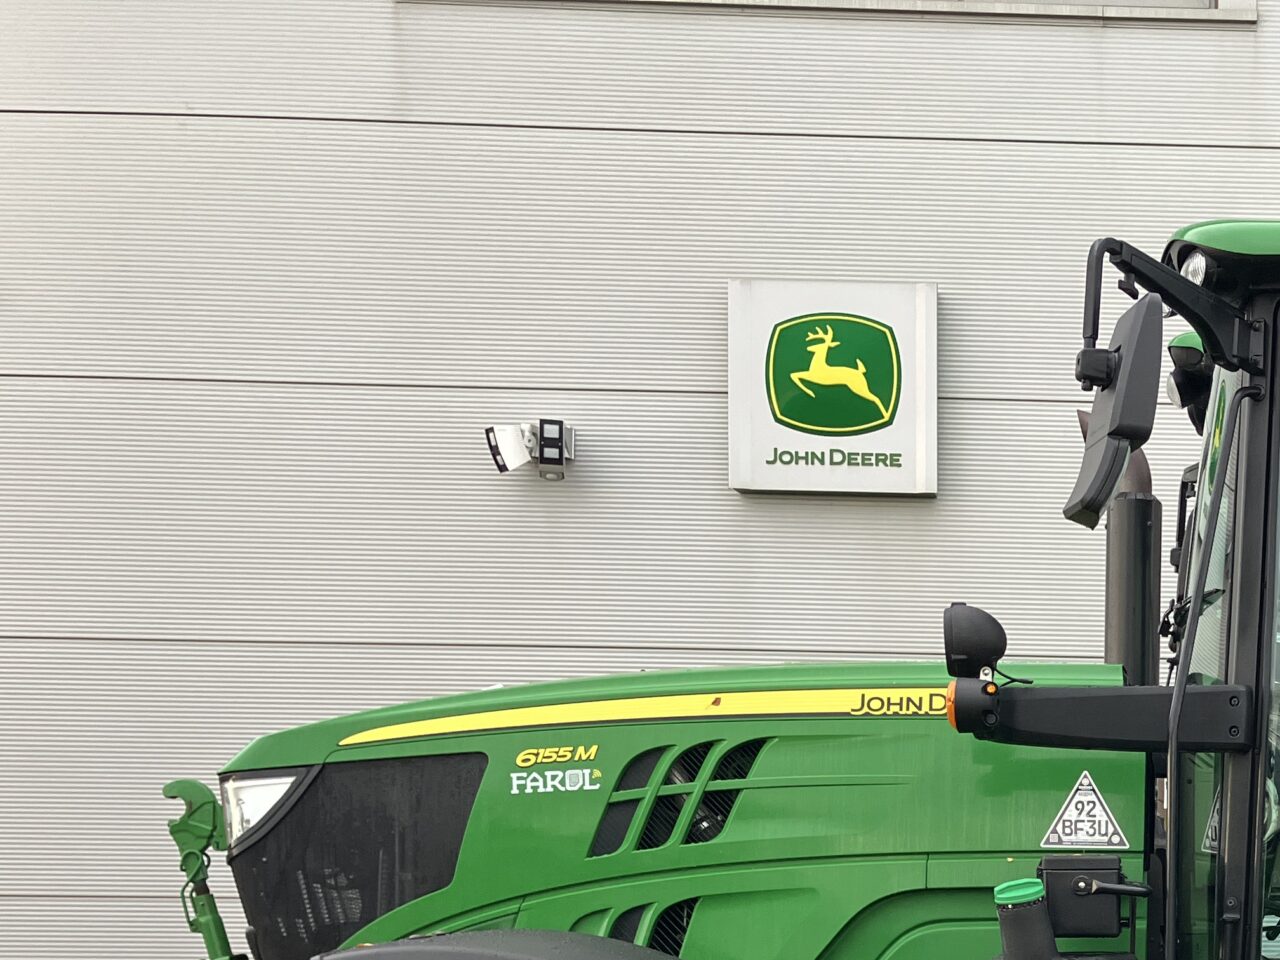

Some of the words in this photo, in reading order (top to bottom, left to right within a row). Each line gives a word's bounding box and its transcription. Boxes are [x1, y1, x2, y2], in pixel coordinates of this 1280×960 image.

[765, 447, 825, 466] JOHN
[829, 449, 903, 468] DEERE
[850, 693, 923, 712] JOHN
[509, 768, 601, 795] FAROL
[1074, 800, 1097, 818] 92
[1061, 819, 1109, 837] BF3U
